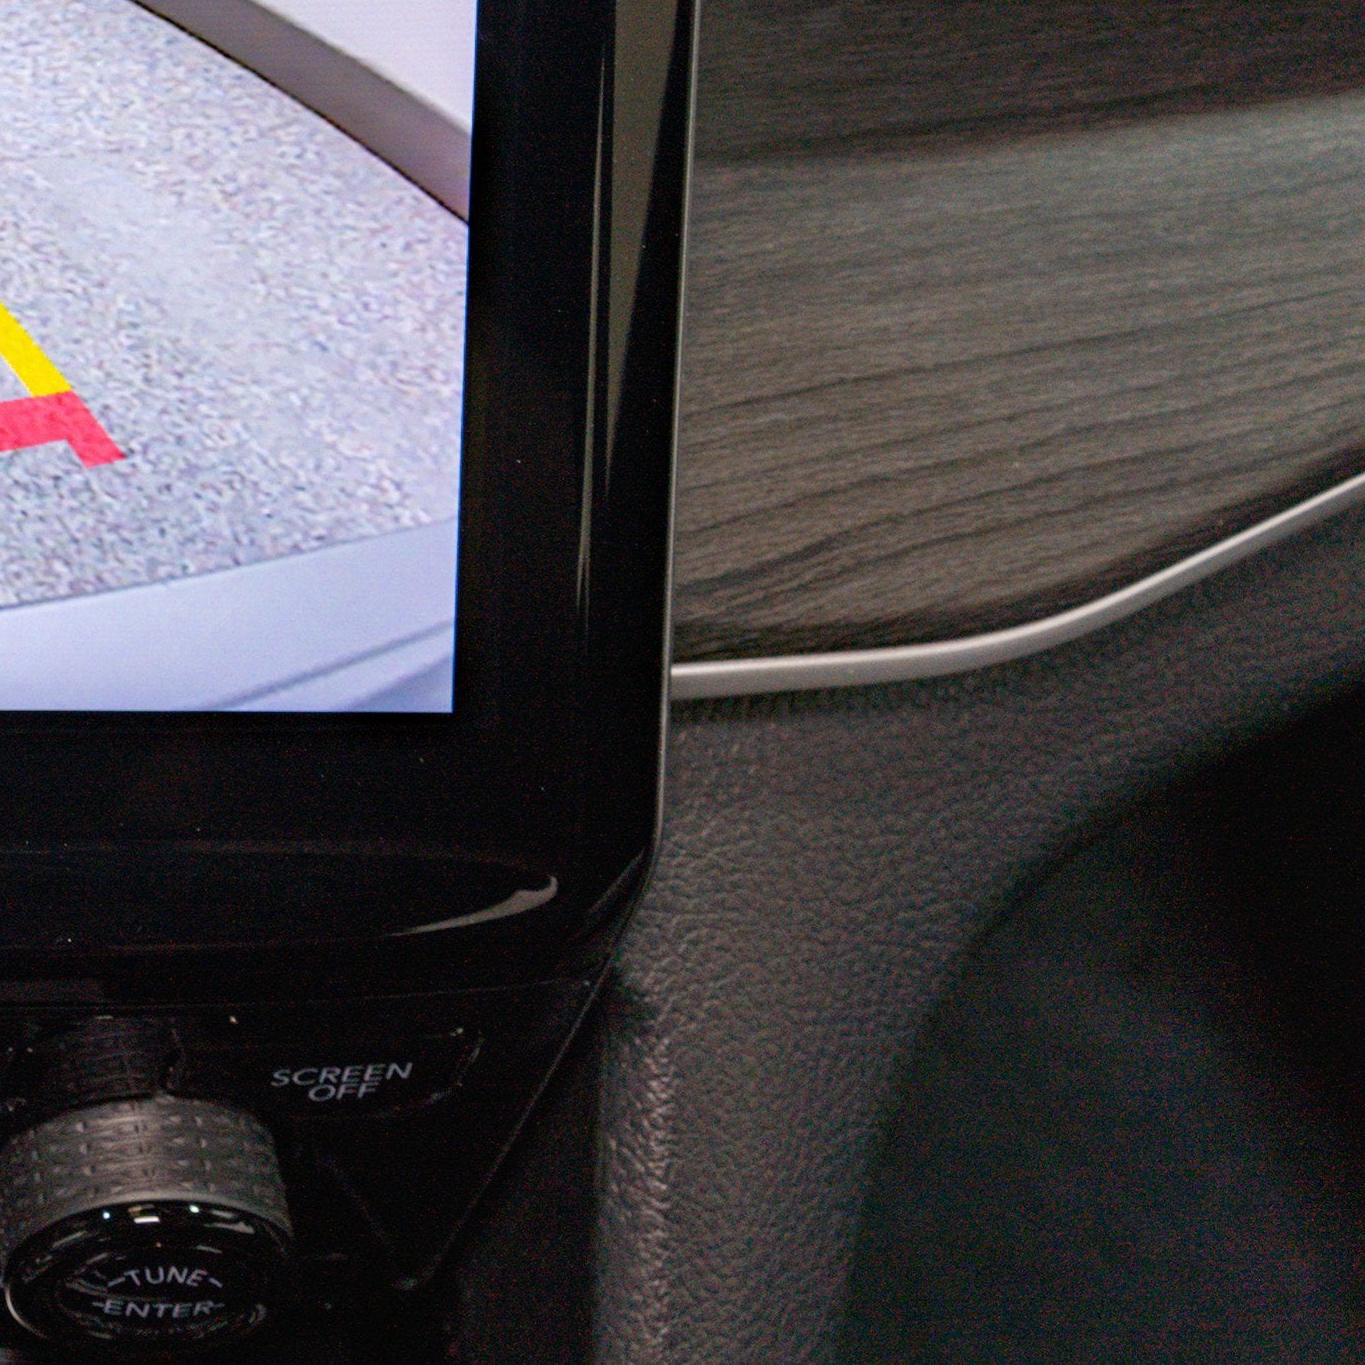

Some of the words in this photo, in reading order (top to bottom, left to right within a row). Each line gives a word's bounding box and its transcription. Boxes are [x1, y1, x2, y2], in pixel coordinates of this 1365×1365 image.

[271, 1062, 413, 1086] SCREEN
[308, 1083, 378, 1102] OFF
[123, 1265, 209, 1287] TUNE
[103, 1299, 216, 1318] ENTER
